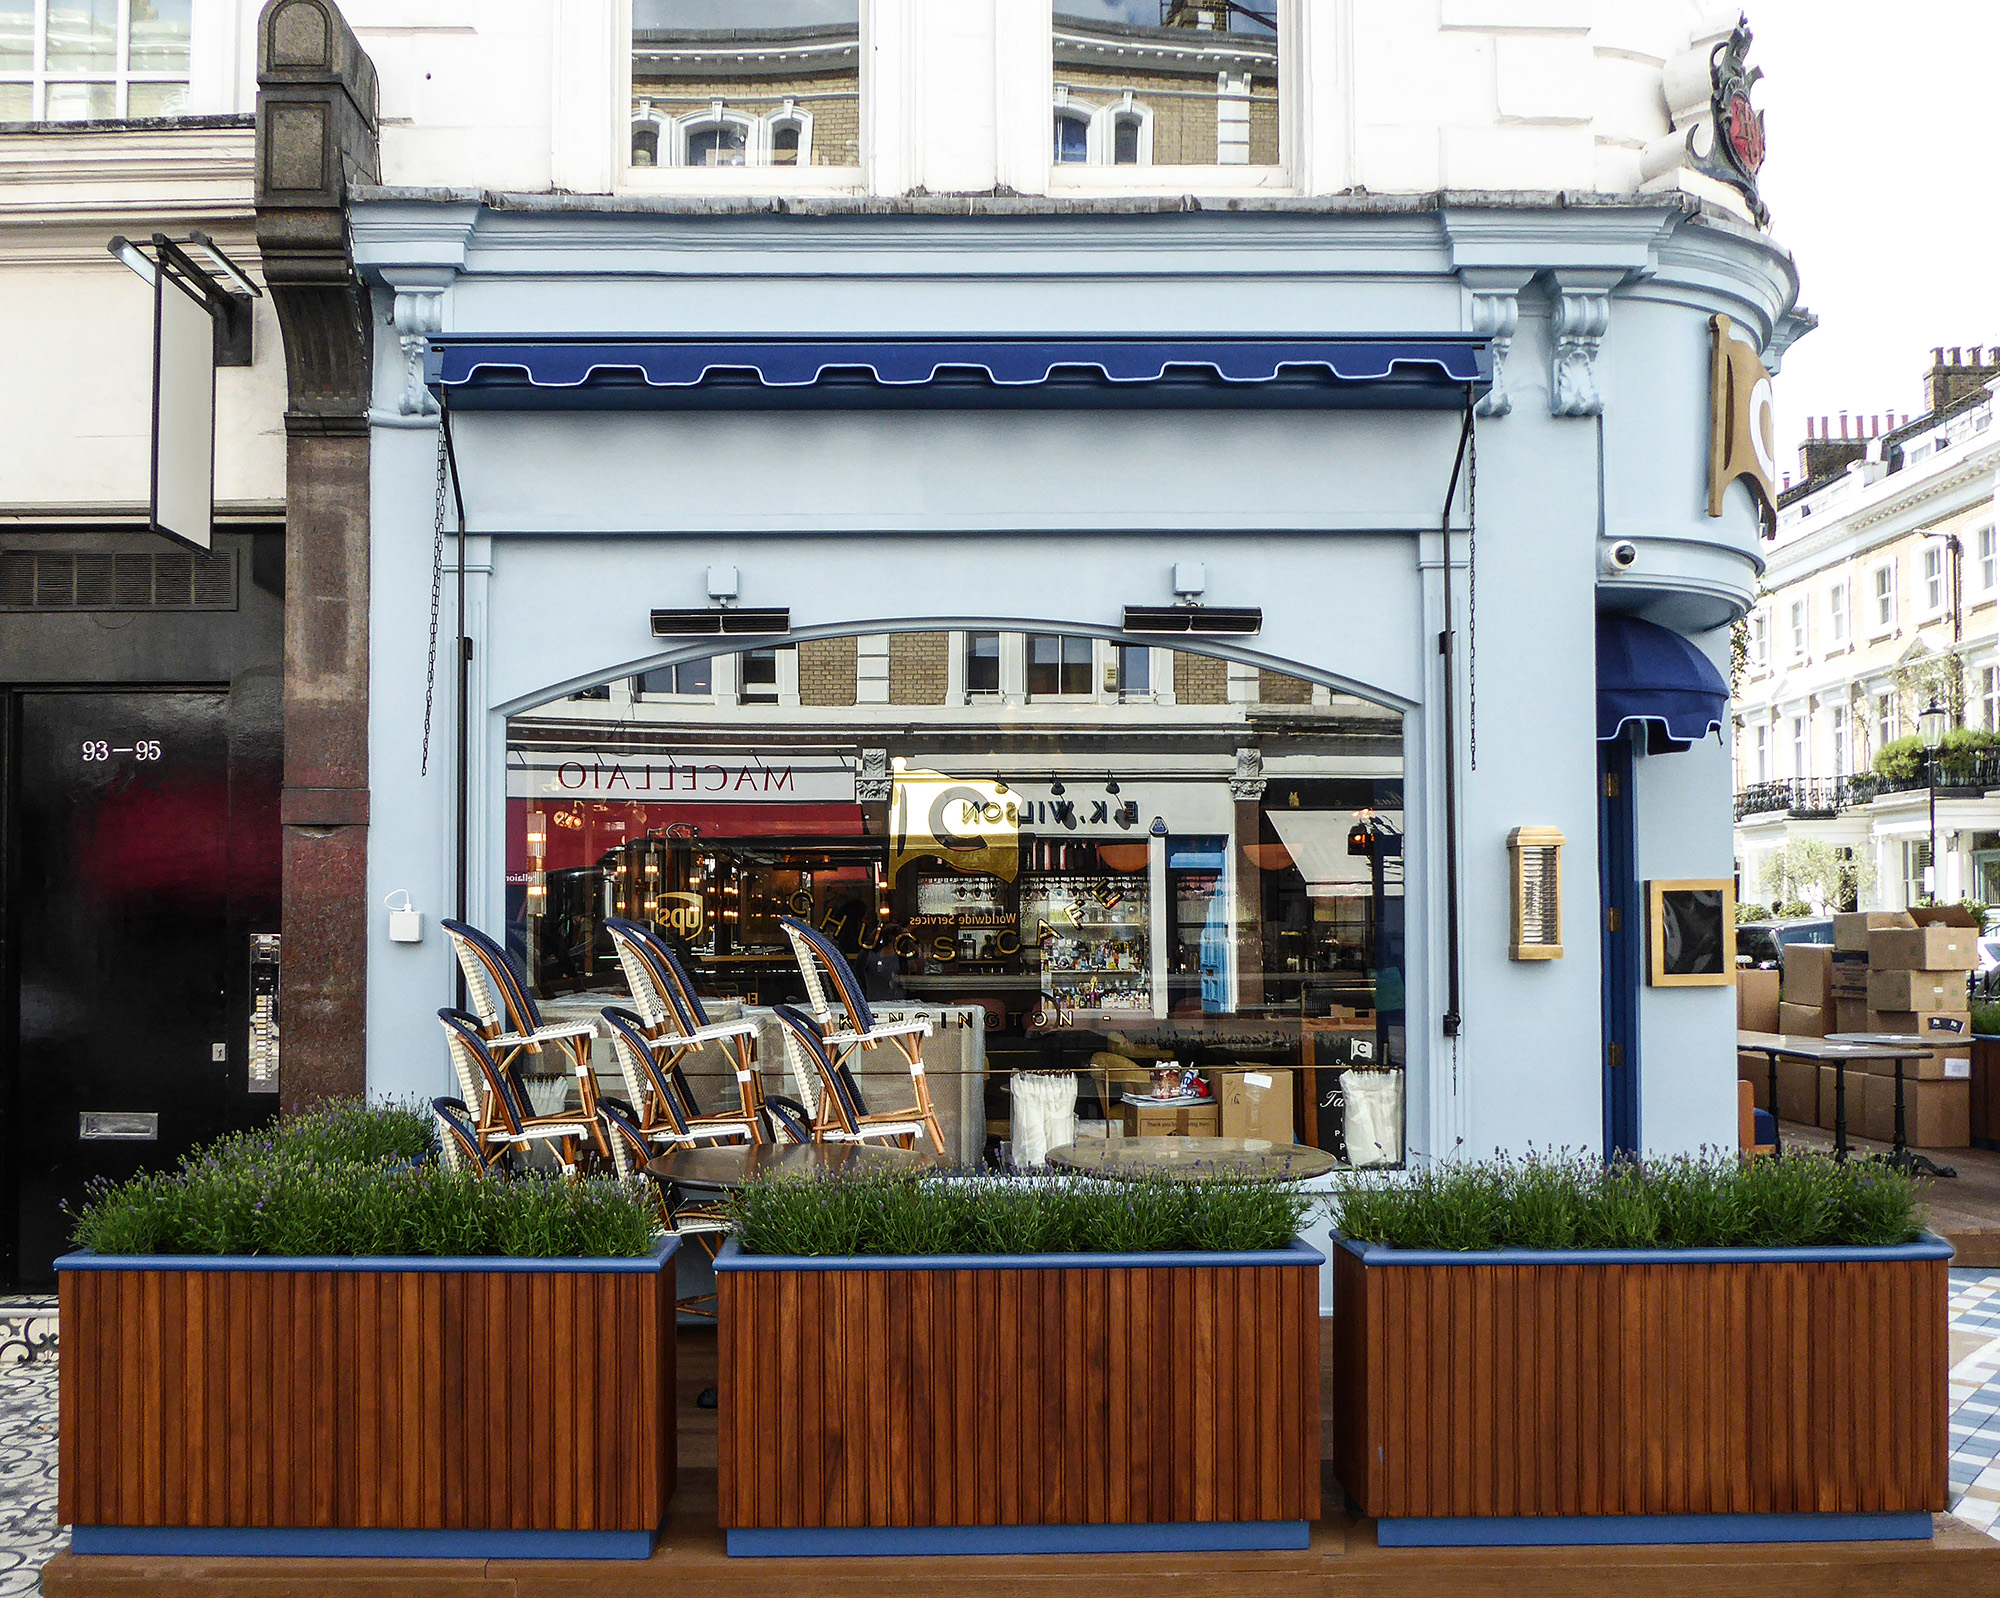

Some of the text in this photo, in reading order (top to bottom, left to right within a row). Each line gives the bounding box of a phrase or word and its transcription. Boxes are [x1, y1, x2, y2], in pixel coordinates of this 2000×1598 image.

[789, 877, 1125, 962] CHUCS CAFE
[838, 1011, 1074, 1030] KNINGTON
